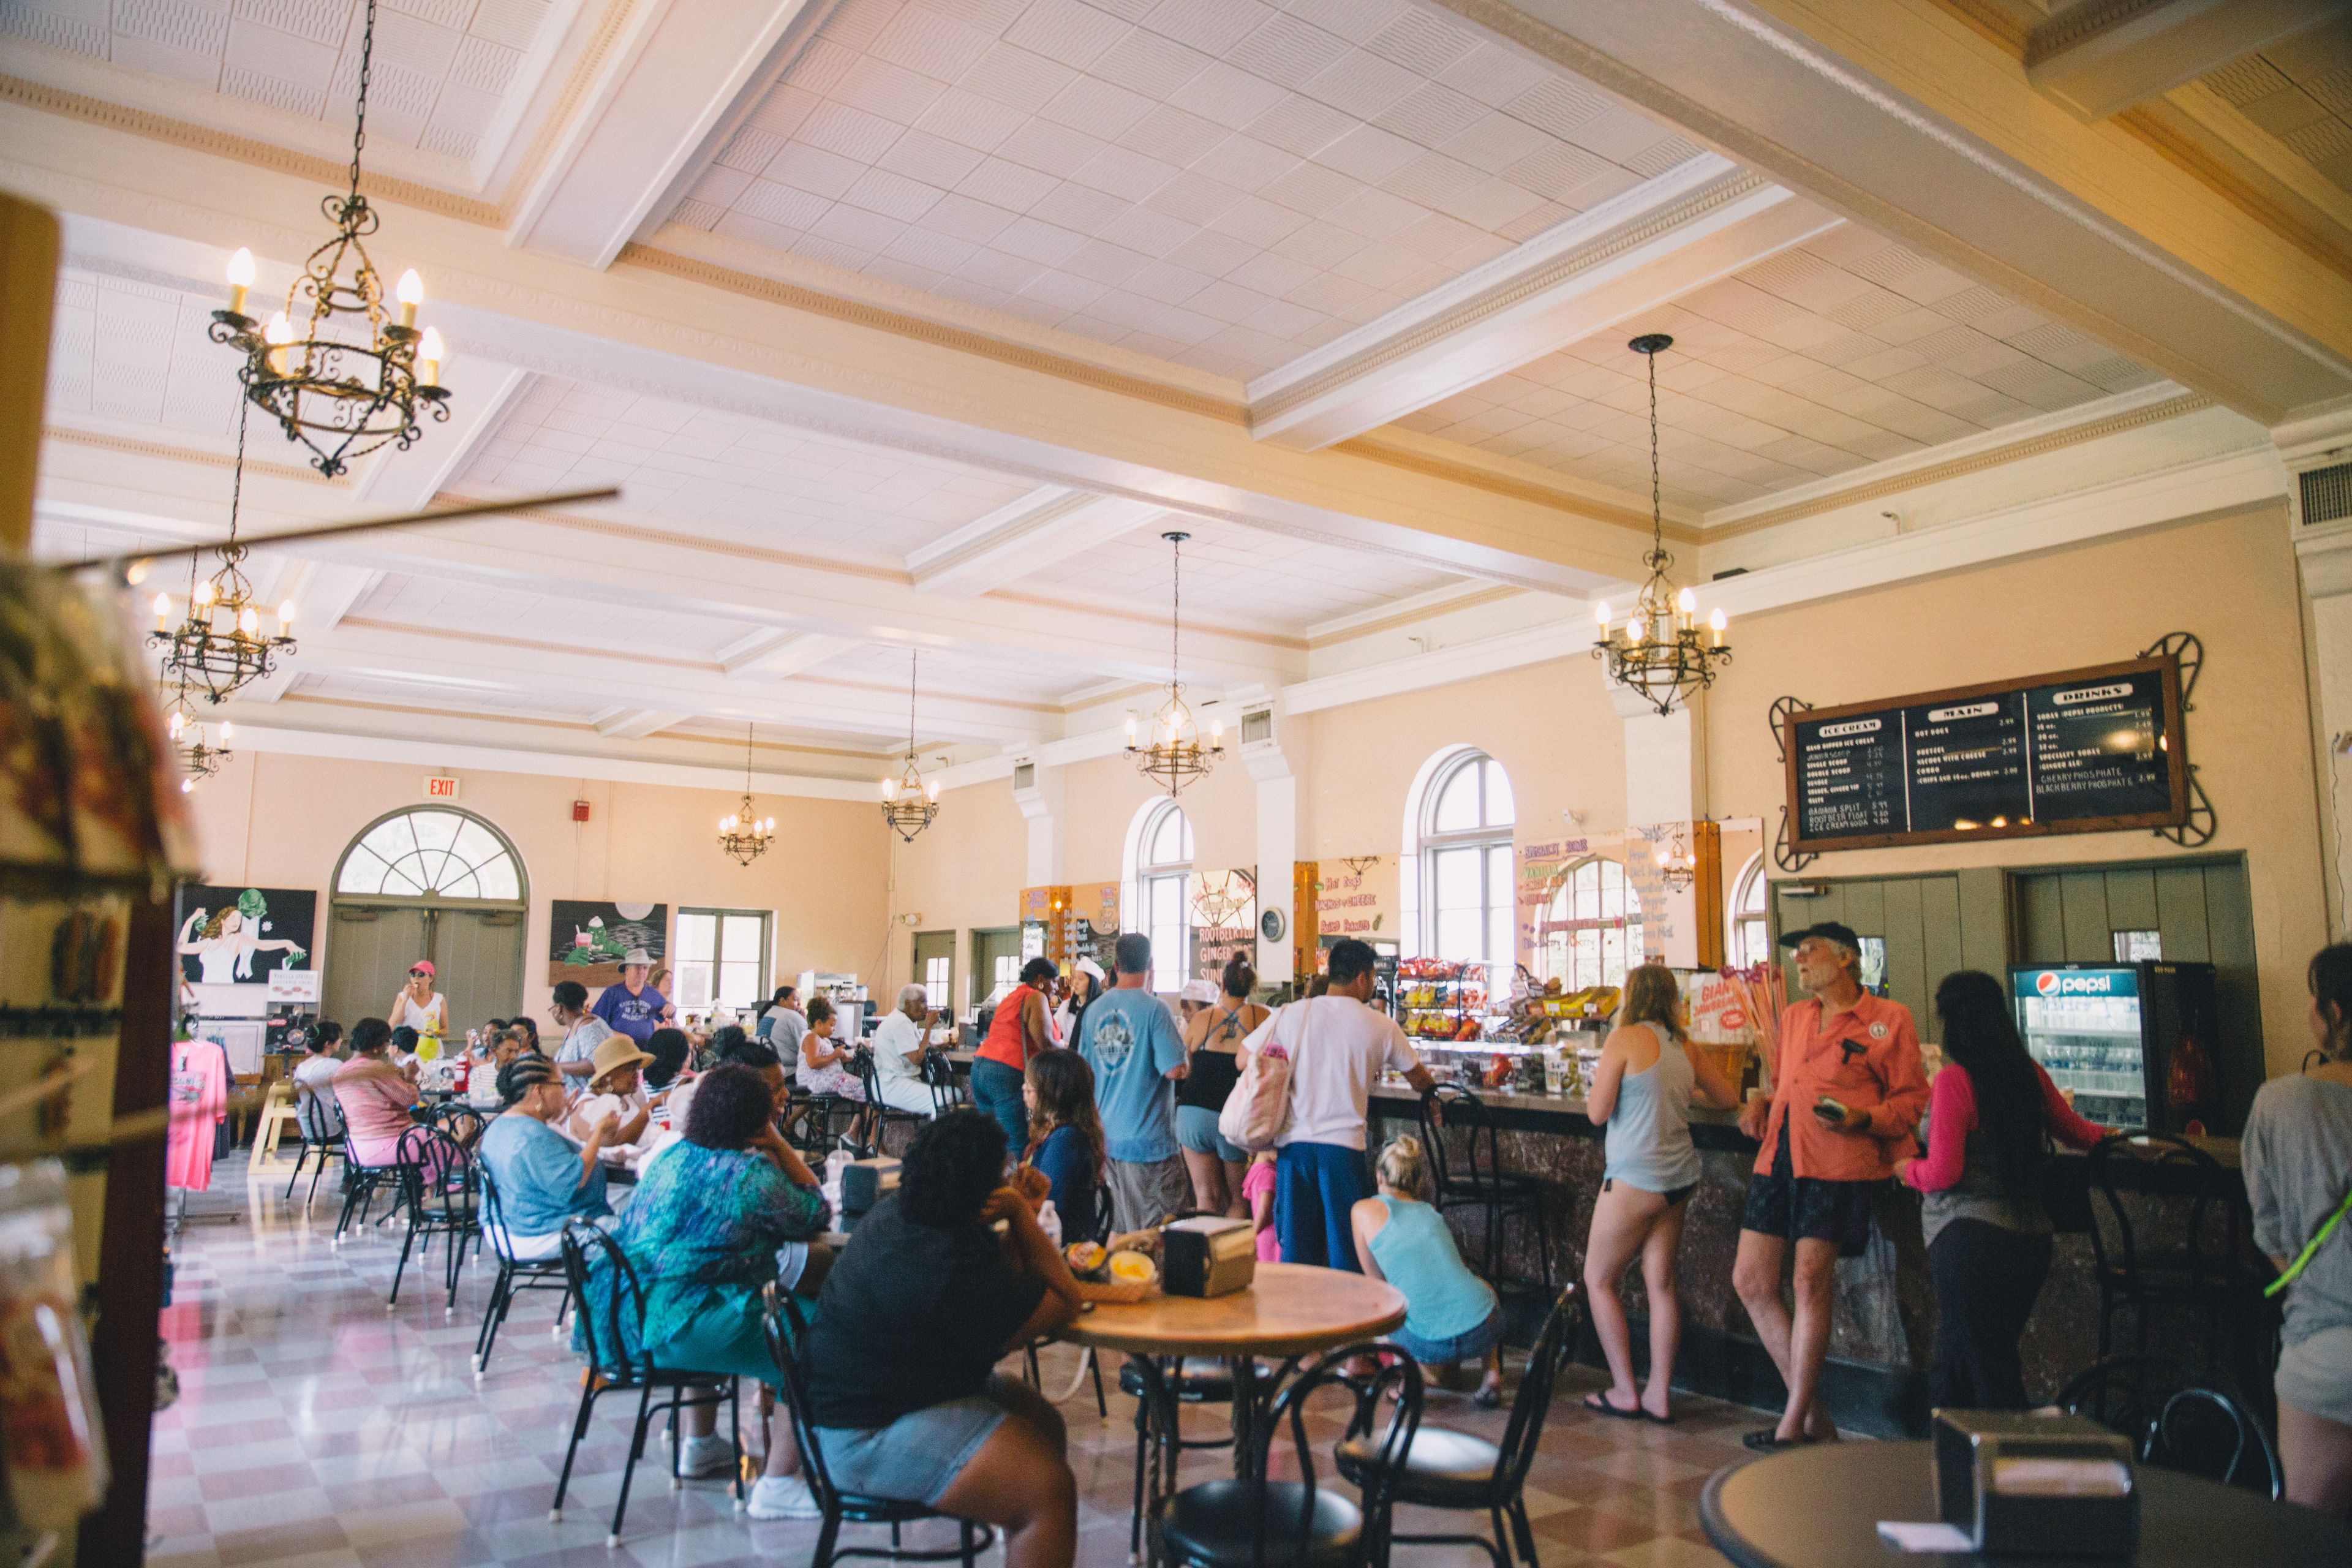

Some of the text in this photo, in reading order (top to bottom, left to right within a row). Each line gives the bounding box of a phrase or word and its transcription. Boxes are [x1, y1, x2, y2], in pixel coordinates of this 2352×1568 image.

[2064, 687, 2122, 701] DRINKS
[1943, 706, 1983, 718] MAIN
[1842, 722, 1876, 732] CREAM
[430, 778, 454, 796] EXIT
[1524, 864, 1559, 878] VANILLA
[1315, 899, 1340, 912] NACHOS
[1348, 894, 1376, 907] CHEESE
[1200, 946, 1232, 963] GINGER
[2062, 974, 2111, 995] pepsi
